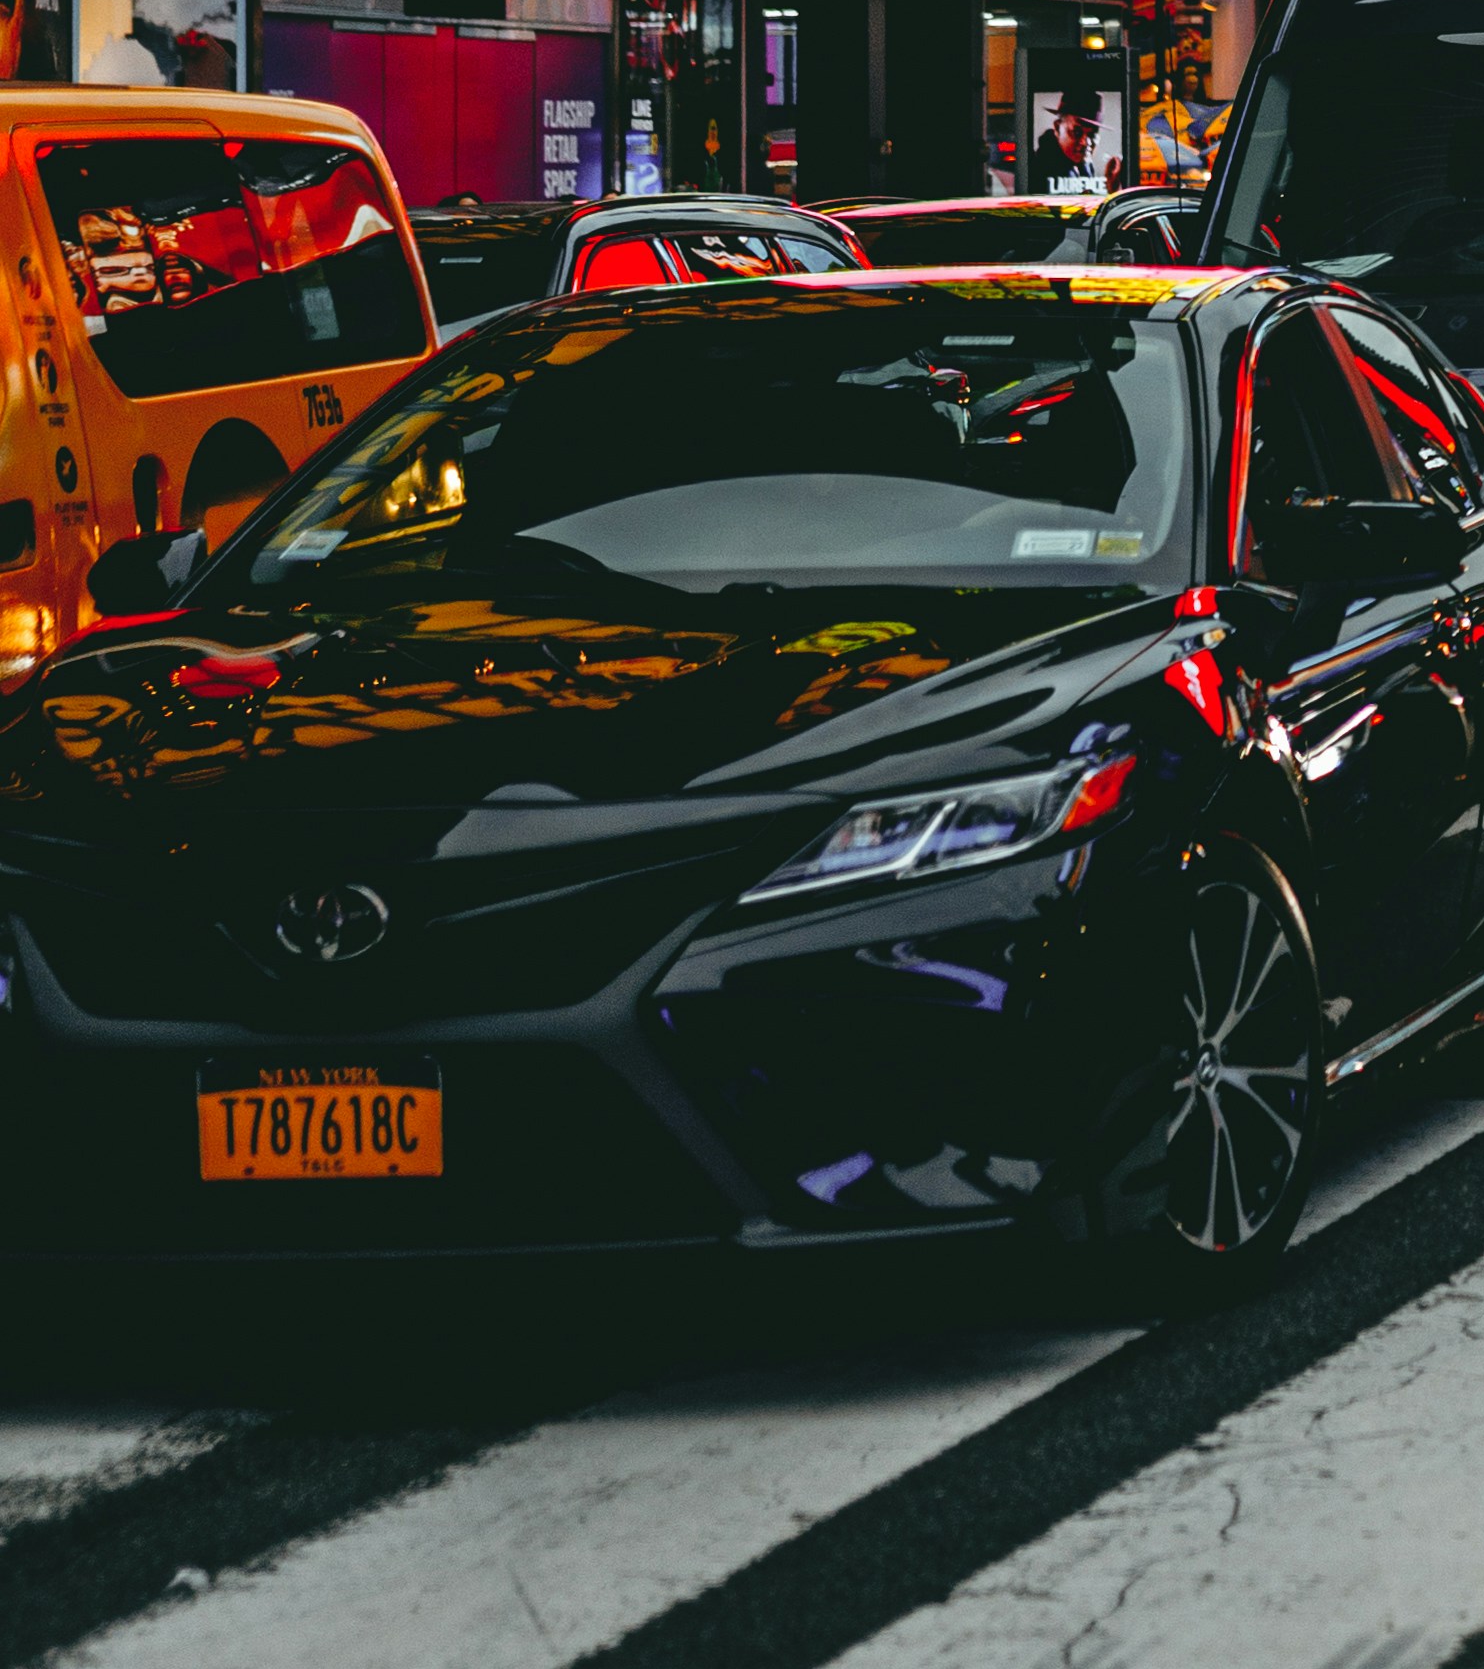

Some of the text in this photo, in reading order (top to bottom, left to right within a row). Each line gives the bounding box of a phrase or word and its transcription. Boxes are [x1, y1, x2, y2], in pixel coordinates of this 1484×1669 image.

[543, 99, 596, 129] FLAGSHIP
[631, 98, 652, 118] LINE
[543, 133, 580, 164] RETAIL
[543, 168, 578, 199] SPACE
[259, 1066, 380, 1087] NEW YORK
[219, 1094, 419, 1157] T787618C
